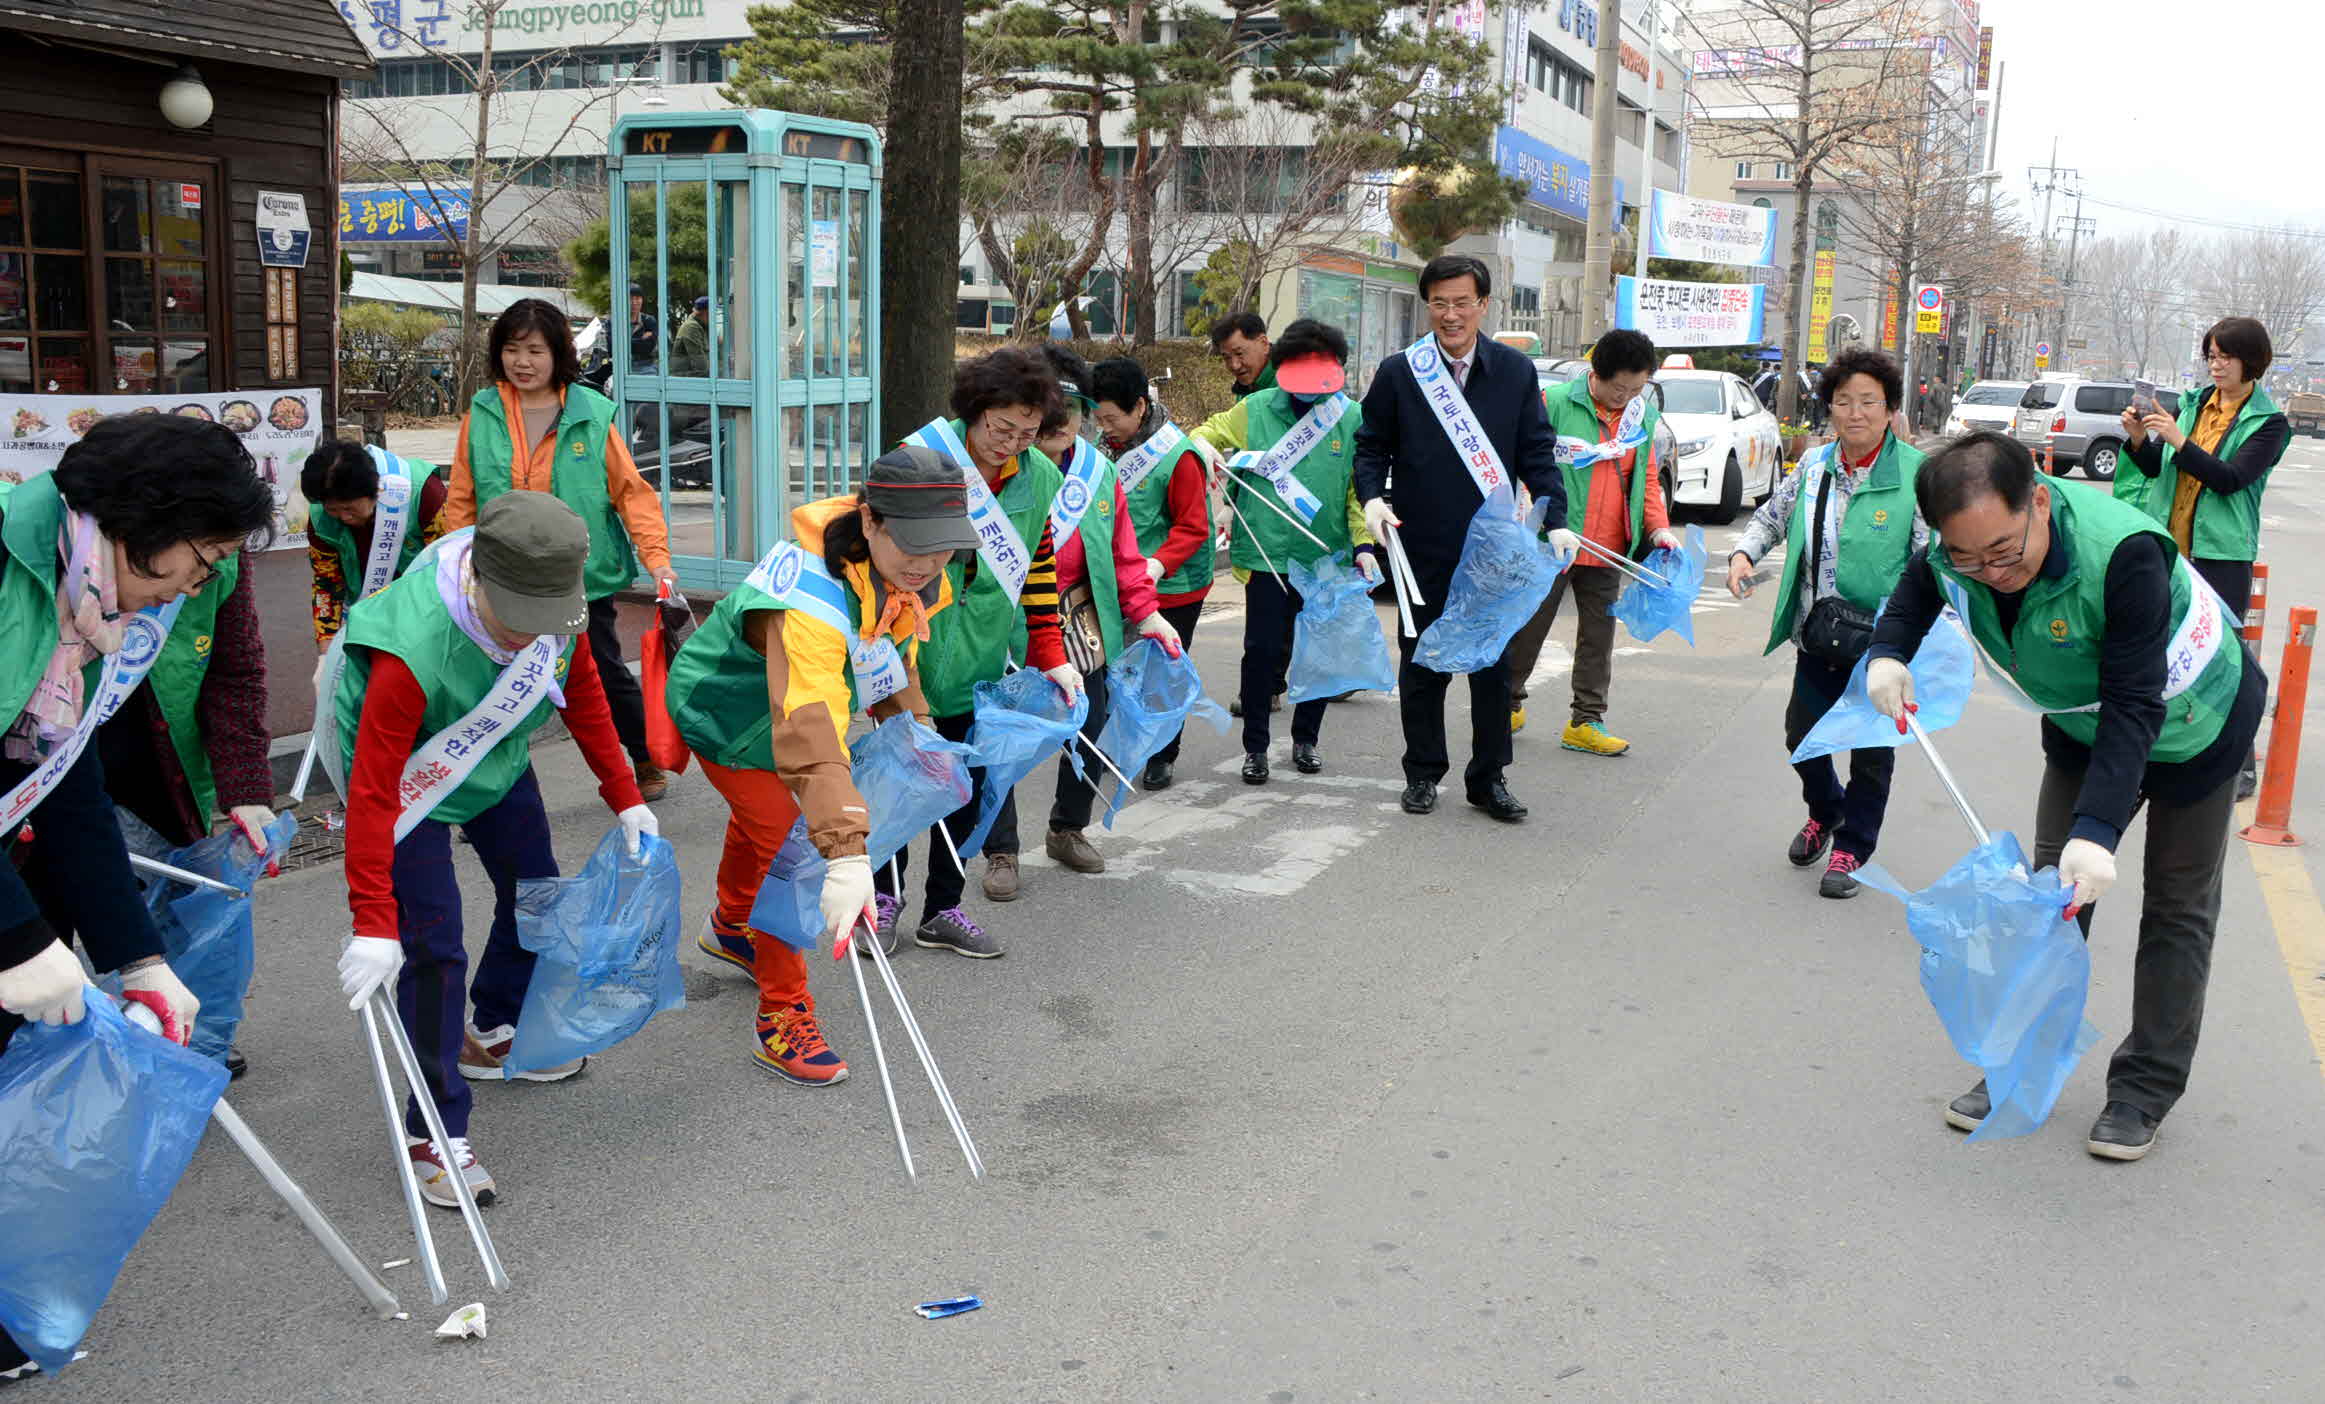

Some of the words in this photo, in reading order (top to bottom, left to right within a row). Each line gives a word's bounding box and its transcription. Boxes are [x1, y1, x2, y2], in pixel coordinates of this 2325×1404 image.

[642, 132, 672, 153] KT
[787, 134, 812, 155] KT
[263, 196, 300, 210] Corona
[1639, 282, 1665, 313] 운전중
[1666, 284, 1691, 313] 휴대폰
[1690, 286, 1721, 313] 사용행위
[1721, 288, 1748, 313] 집중단속
[1119, 452, 1148, 486] 깨끗하
[375, 519, 399, 562] 깨끗하고
[978, 520, 1023, 577] 깨끗하고
[493, 641, 550, 714] 깨끗하고
[443, 716, 502, 761] 쾌적한
[398, 760, 454, 816] 생활환
